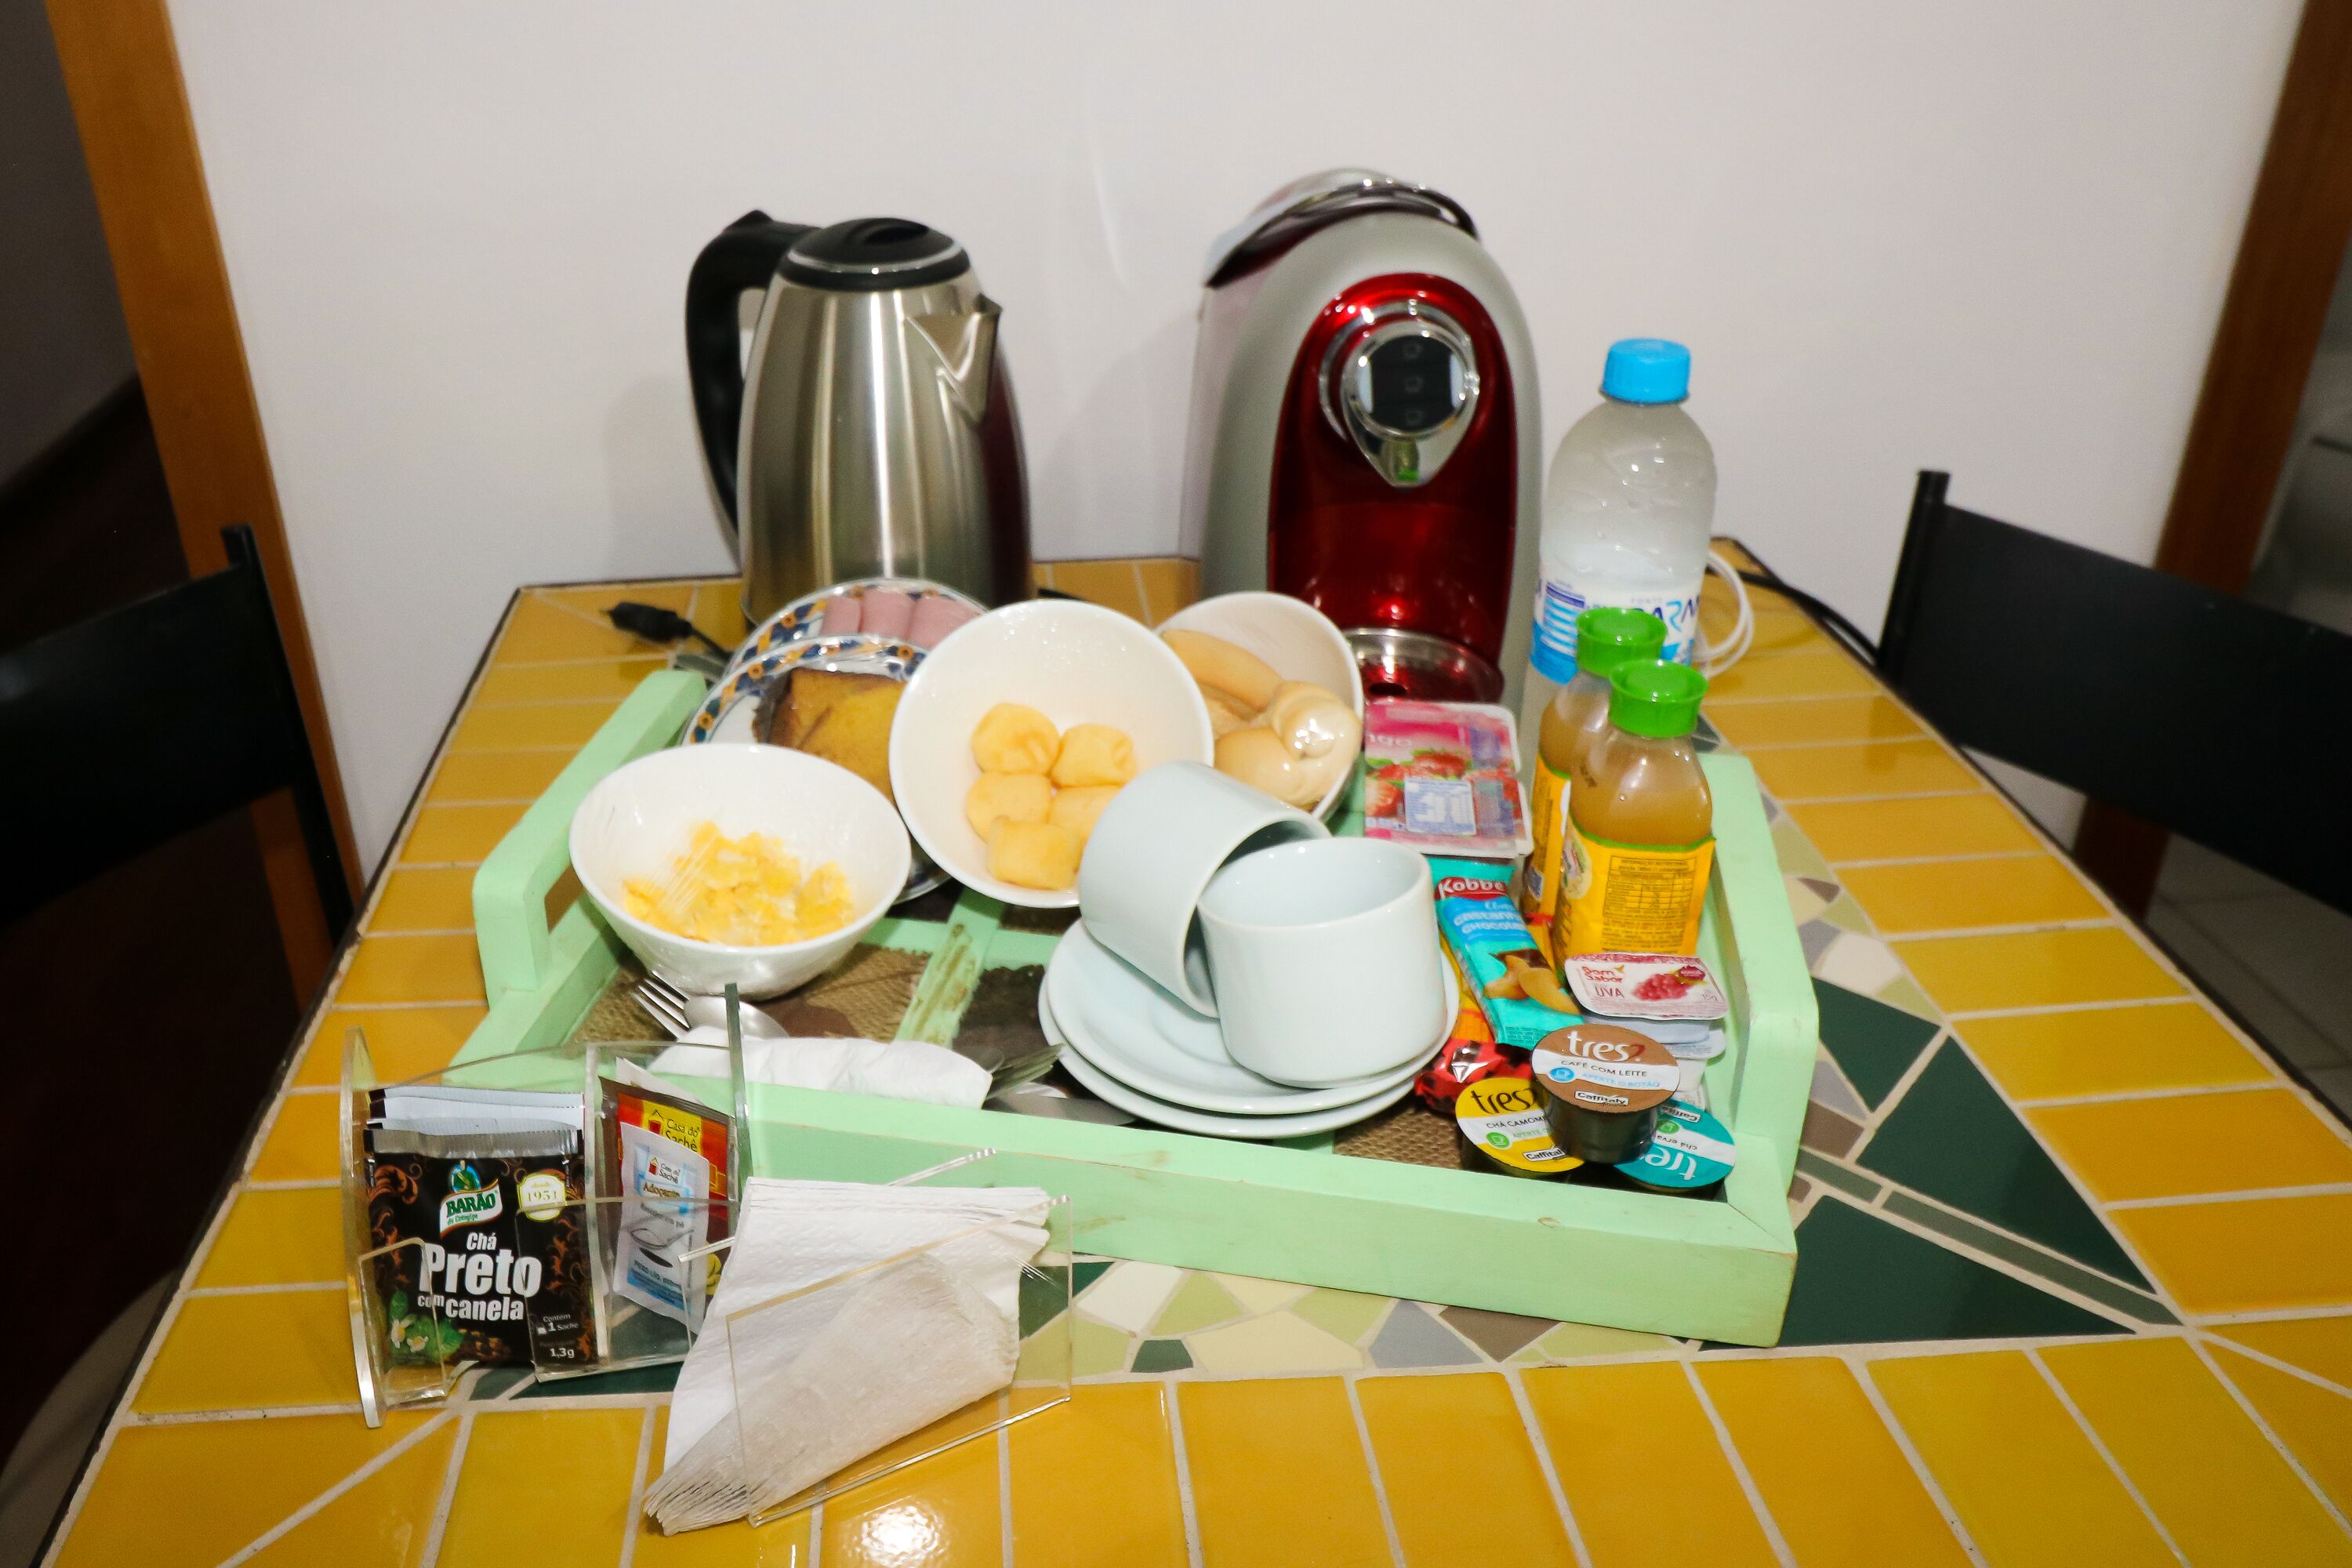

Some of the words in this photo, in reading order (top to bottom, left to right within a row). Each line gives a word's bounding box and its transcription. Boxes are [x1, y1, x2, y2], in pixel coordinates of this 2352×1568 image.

[1594, 986, 1625, 999] UVA
[1561, 1059, 1588, 1069] CAFÉ
[1590, 1065, 1616, 1076] COM
[1618, 1069, 1648, 1078] LEITE
[1577, 1091, 1627, 1105] Caffitaly
[666, 1118, 686, 1134] Casa
[687, 1126, 699, 1138] do
[446, 1191, 496, 1218] BARÃO
[527, 1189, 557, 1203] 1951
[465, 1231, 498, 1251] Chá
[419, 1241, 543, 1298] Preto
[417, 1294, 445, 1308] com
[445, 1296, 524, 1321] canela
[547, 1322, 557, 1332] 1
[550, 1347, 575, 1359] 1,3g
